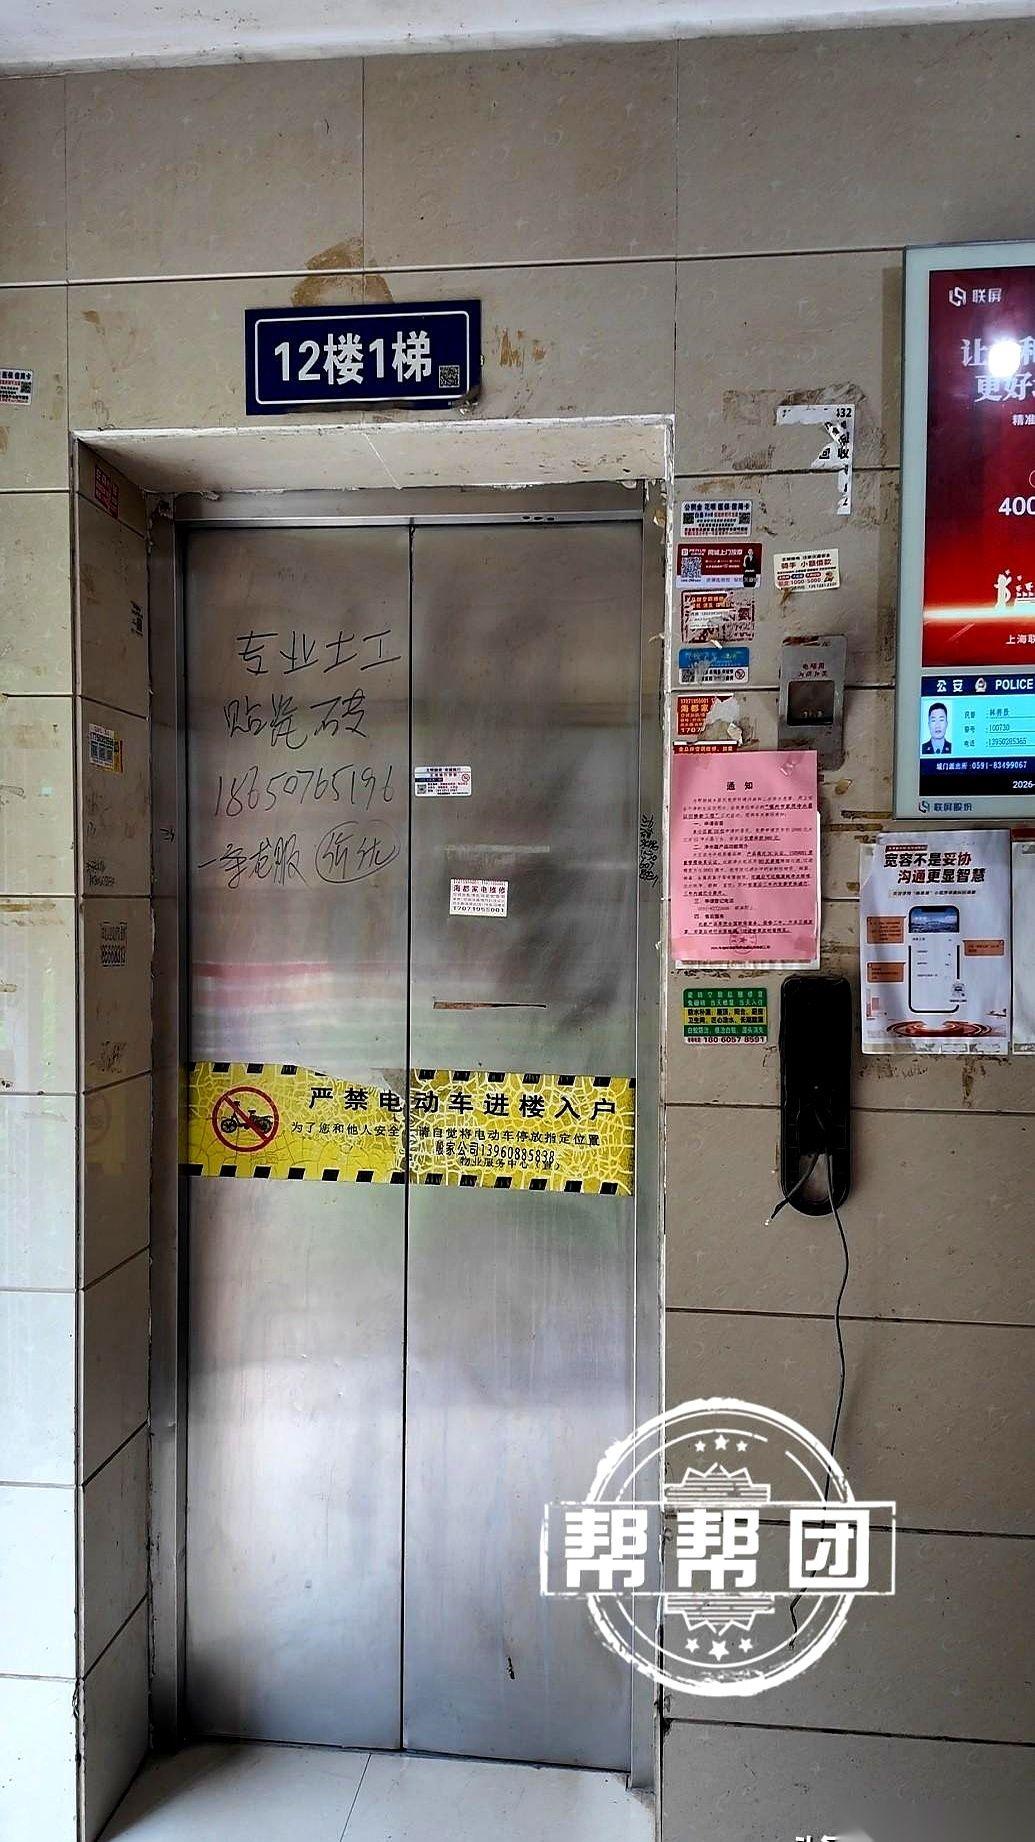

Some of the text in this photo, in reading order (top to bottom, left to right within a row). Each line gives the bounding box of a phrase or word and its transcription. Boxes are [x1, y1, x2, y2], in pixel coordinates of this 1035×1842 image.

[972, 288, 1002, 304] 联屏
[274, 330, 432, 385] 12楼1梯
[974, 371, 1035, 403] 更好
[936, 678, 1034, 693] 公安 POLICE
[215, 765, 394, 817] 18650765196
[884, 852, 972, 868] 宽容不是妥协
[897, 868, 986, 884] 沟通更显智慧
[308, 1087, 616, 1120] 严禁电动车进楼入户
[291, 1121, 400, 1137] 为了您和他人安全
